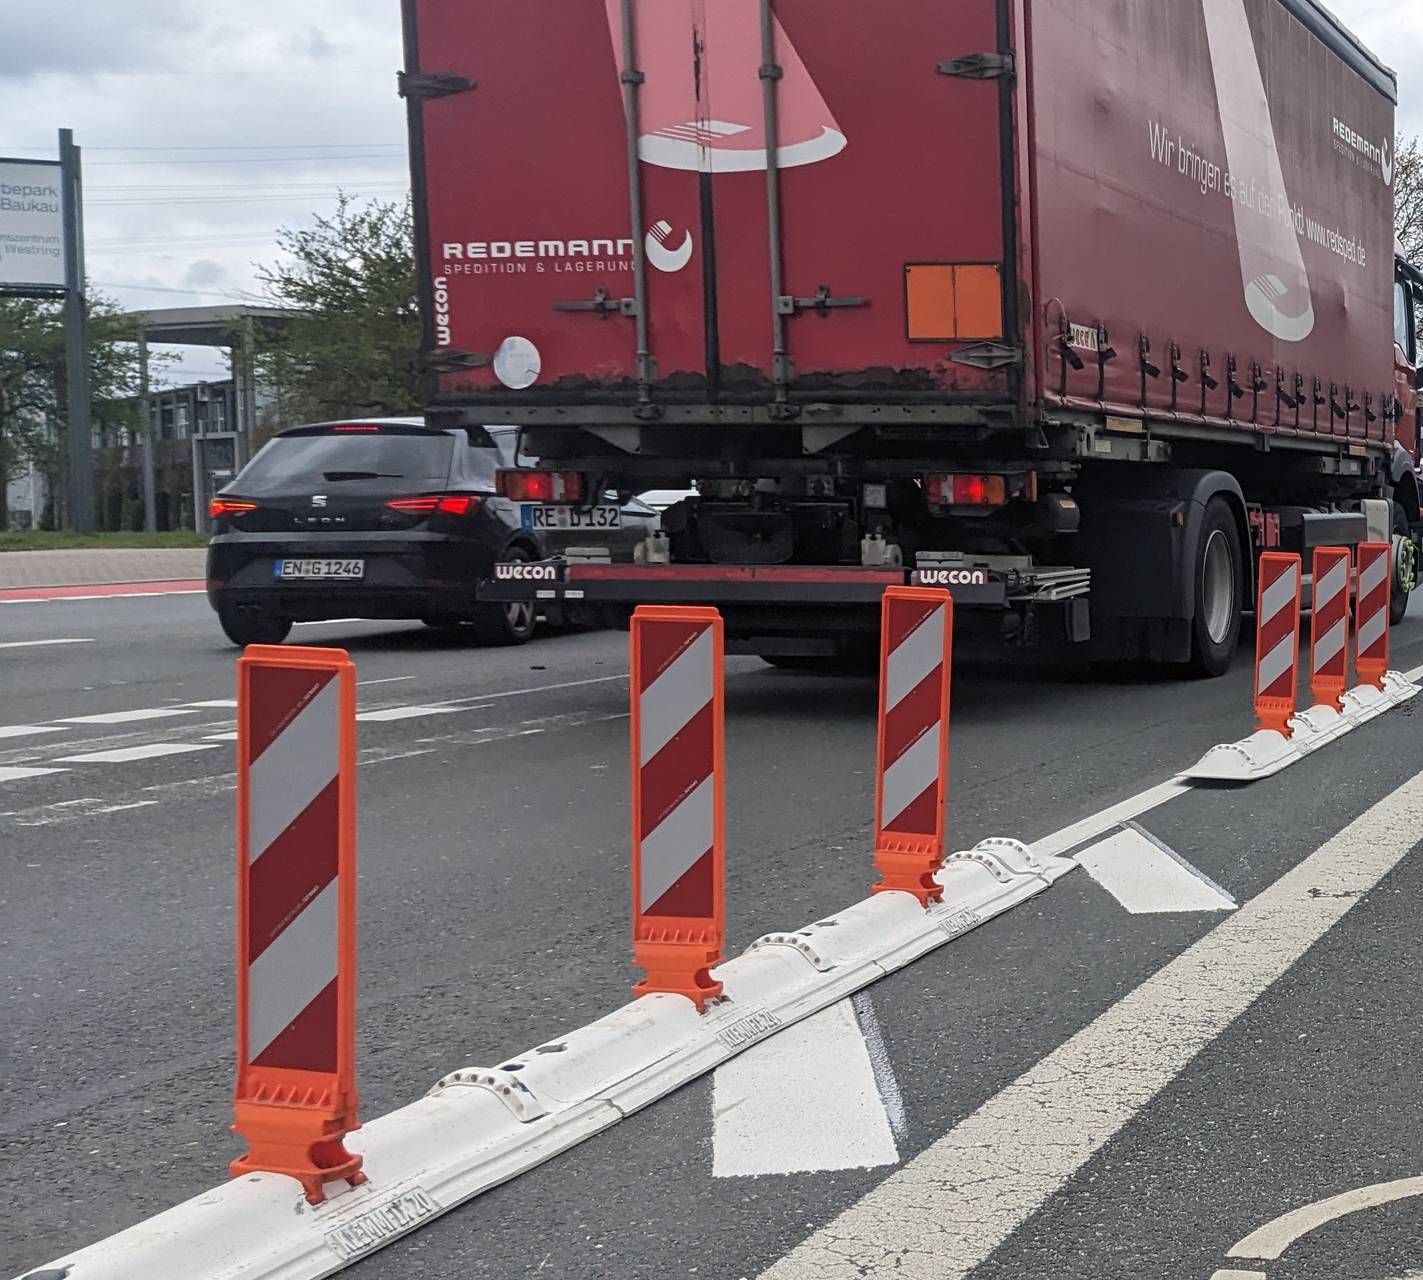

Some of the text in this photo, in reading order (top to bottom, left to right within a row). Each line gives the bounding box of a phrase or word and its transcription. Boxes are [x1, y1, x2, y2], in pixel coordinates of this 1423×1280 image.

[1332, 116, 1381, 164] REDEMANN
[1148, 119, 1175, 168] Wir
[1178, 135, 1221, 195] bringen
[1224, 172, 1237, 200] es
[0, 183, 58, 197] bepark
[1, 198, 58, 213] Baukau
[5, 244, 60, 258] Westring
[442, 239, 634, 259] REDEMANN
[444, 263, 527, 275] SPEDITION
[536, 262, 545, 273] &
[434, 276, 451, 346] wecon
[533, 507, 557, 528] RE
[584, 507, 620, 527] 132
[283, 561, 361, 575] EN G 1246
[496, 565, 556, 580] wecon
[920, 569, 984, 585] wecon
[408, 1191, 433, 1218] 20
